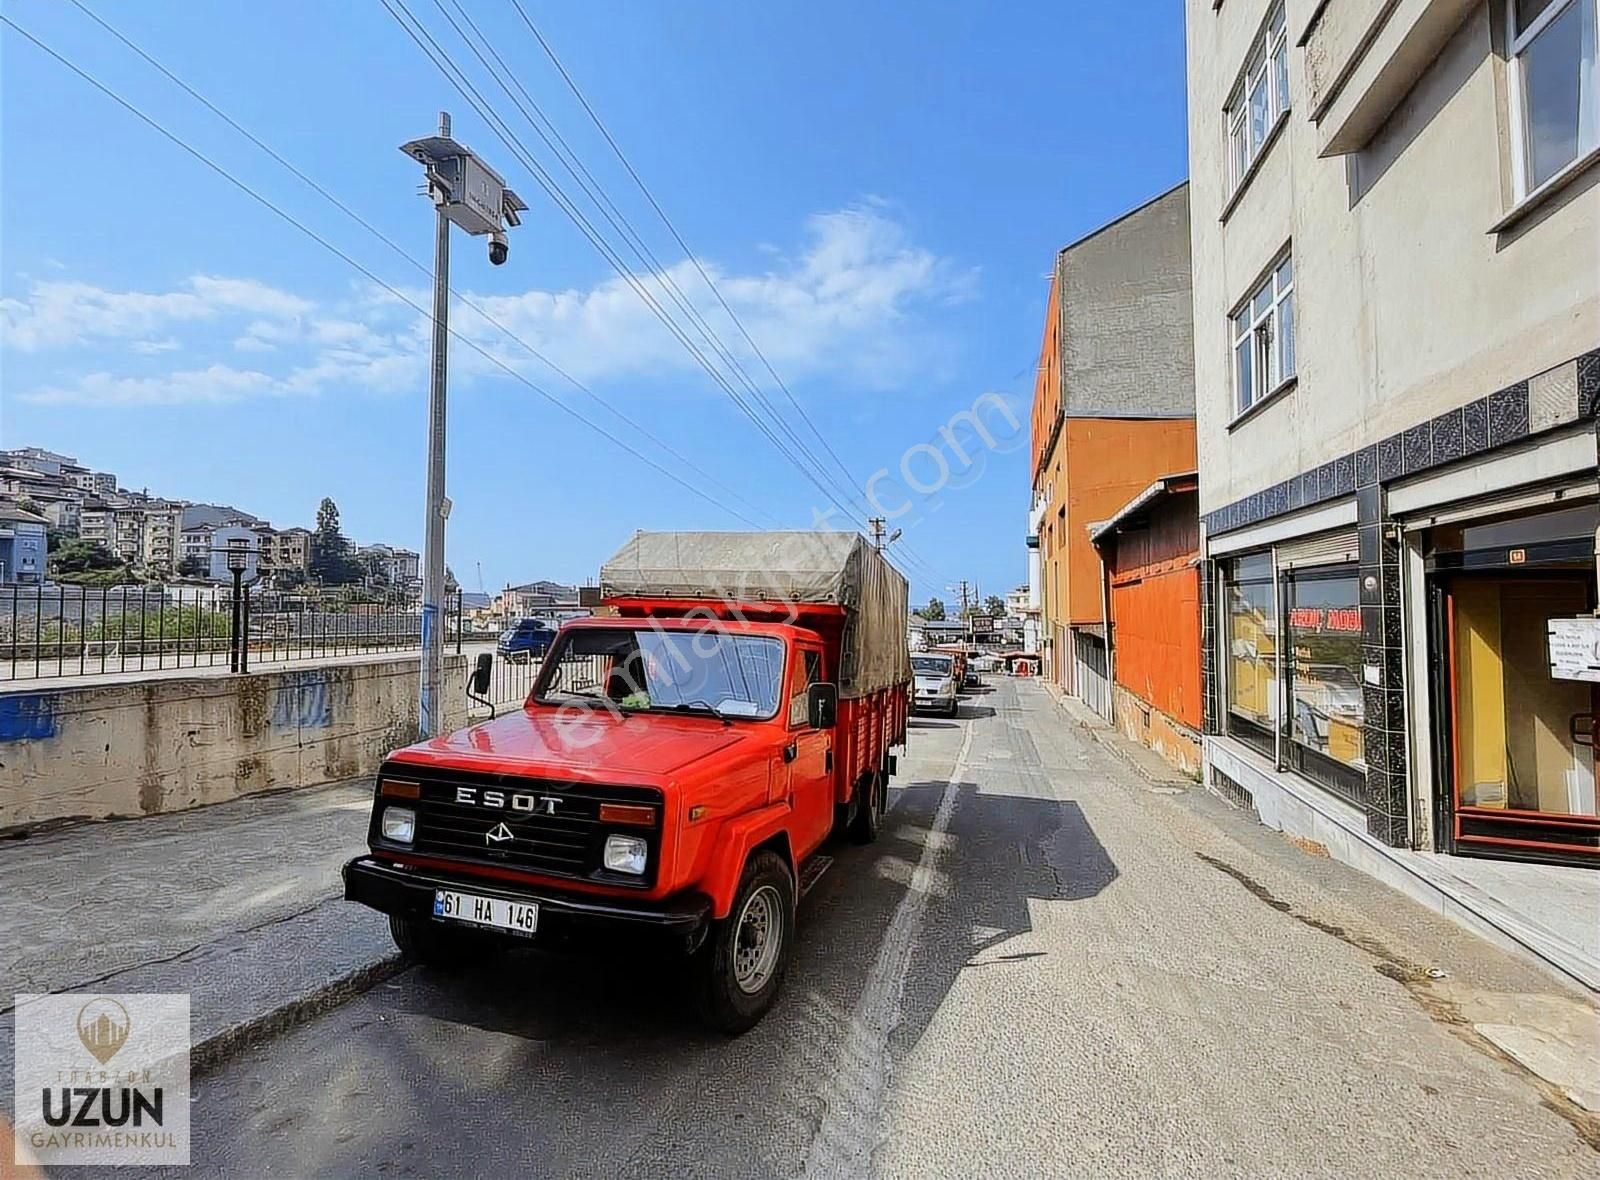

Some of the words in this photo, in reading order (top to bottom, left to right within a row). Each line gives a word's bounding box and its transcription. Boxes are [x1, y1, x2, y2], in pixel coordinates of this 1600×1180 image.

[455, 787, 563, 814] ESOT
[444, 894, 460, 916] 61
[475, 898, 492, 921] HA
[508, 905, 533, 928] 146
